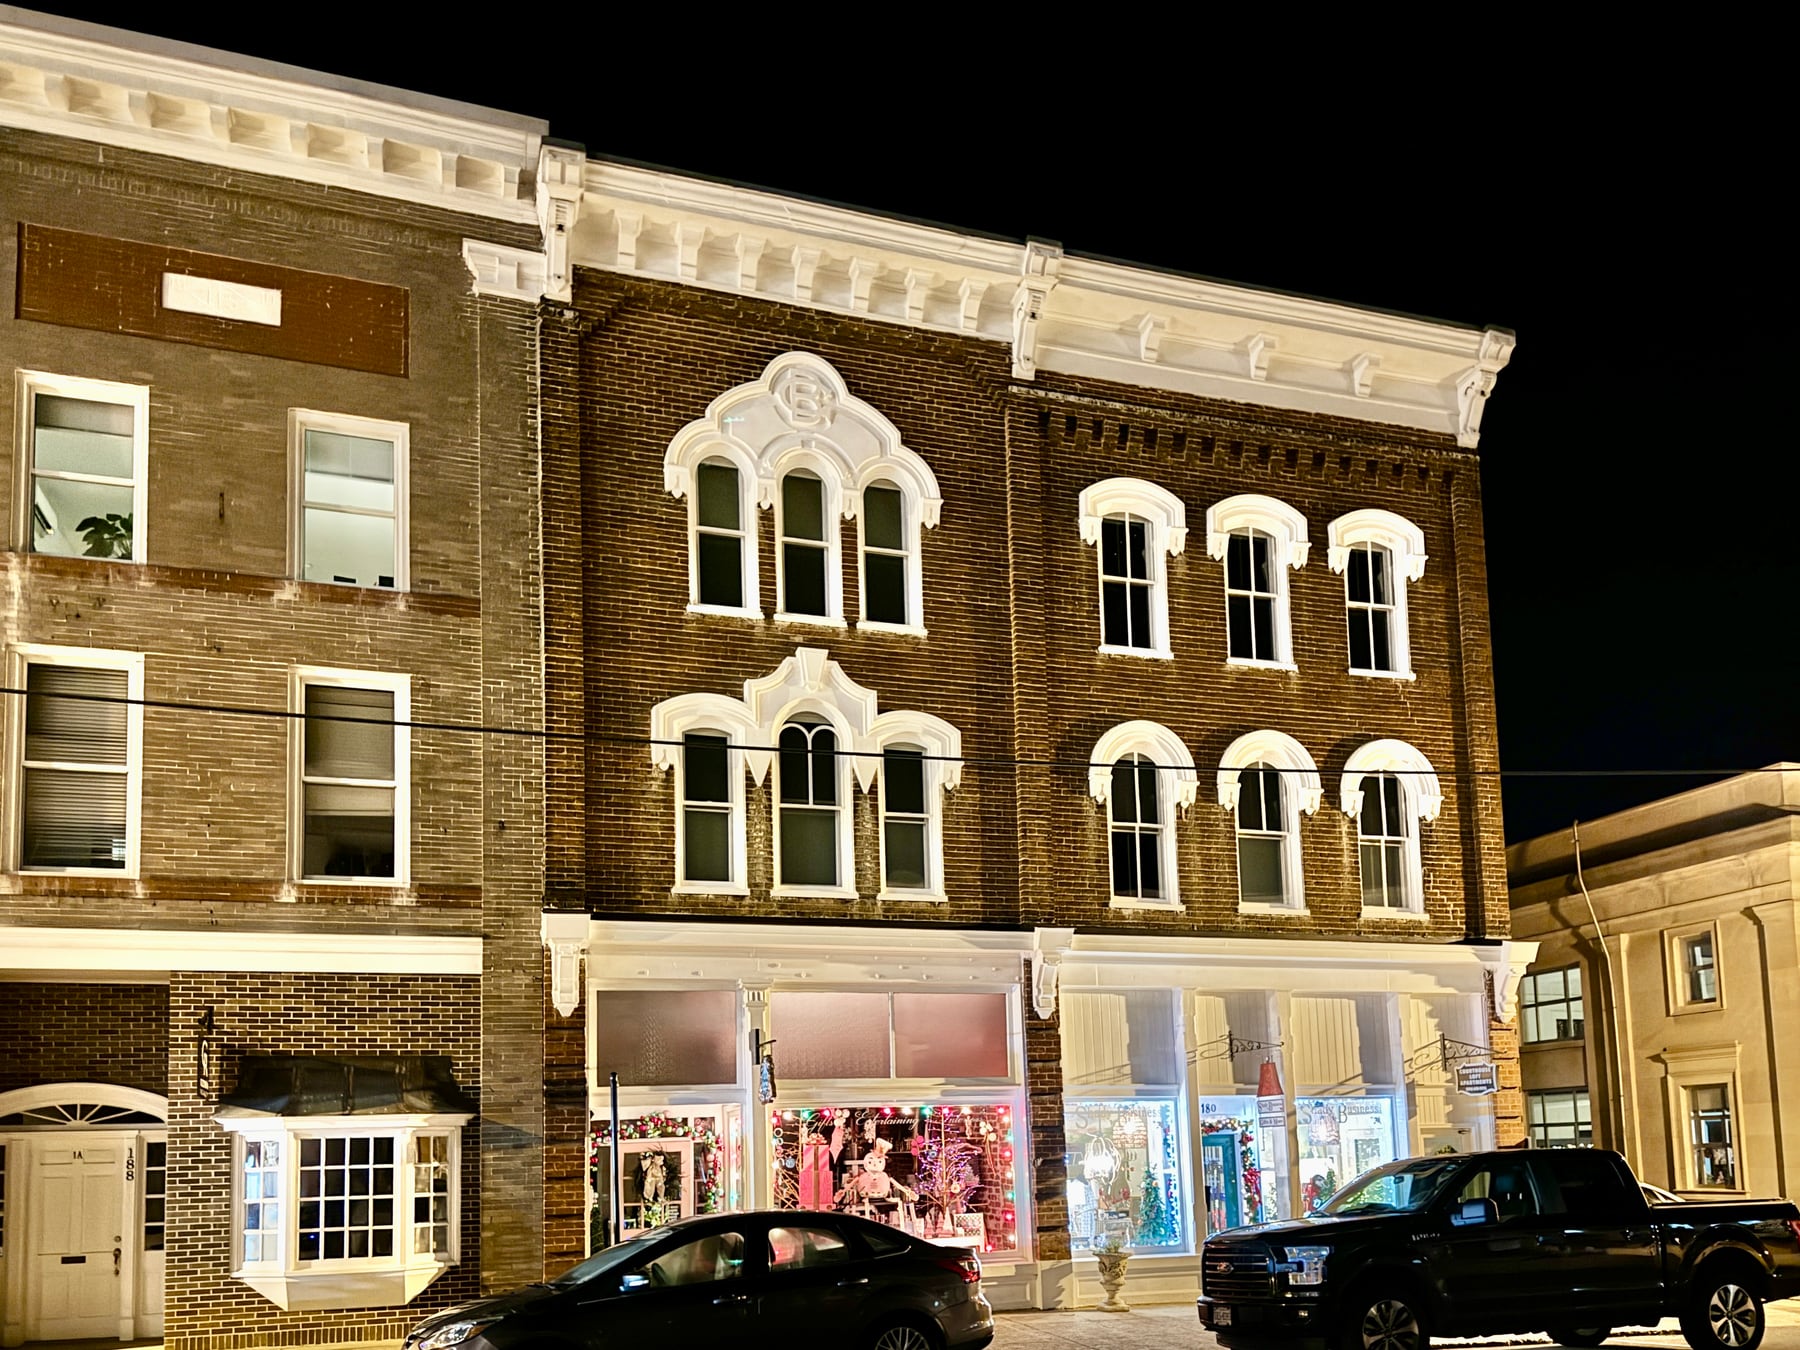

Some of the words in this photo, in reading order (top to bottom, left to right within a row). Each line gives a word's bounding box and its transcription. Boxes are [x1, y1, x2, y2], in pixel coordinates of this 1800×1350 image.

[1201, 1103, 1217, 1114] 180
[805, 1112, 834, 1134] Gifts
[73, 1151, 83, 1160] 1A
[126, 1147, 135, 1181] 188
